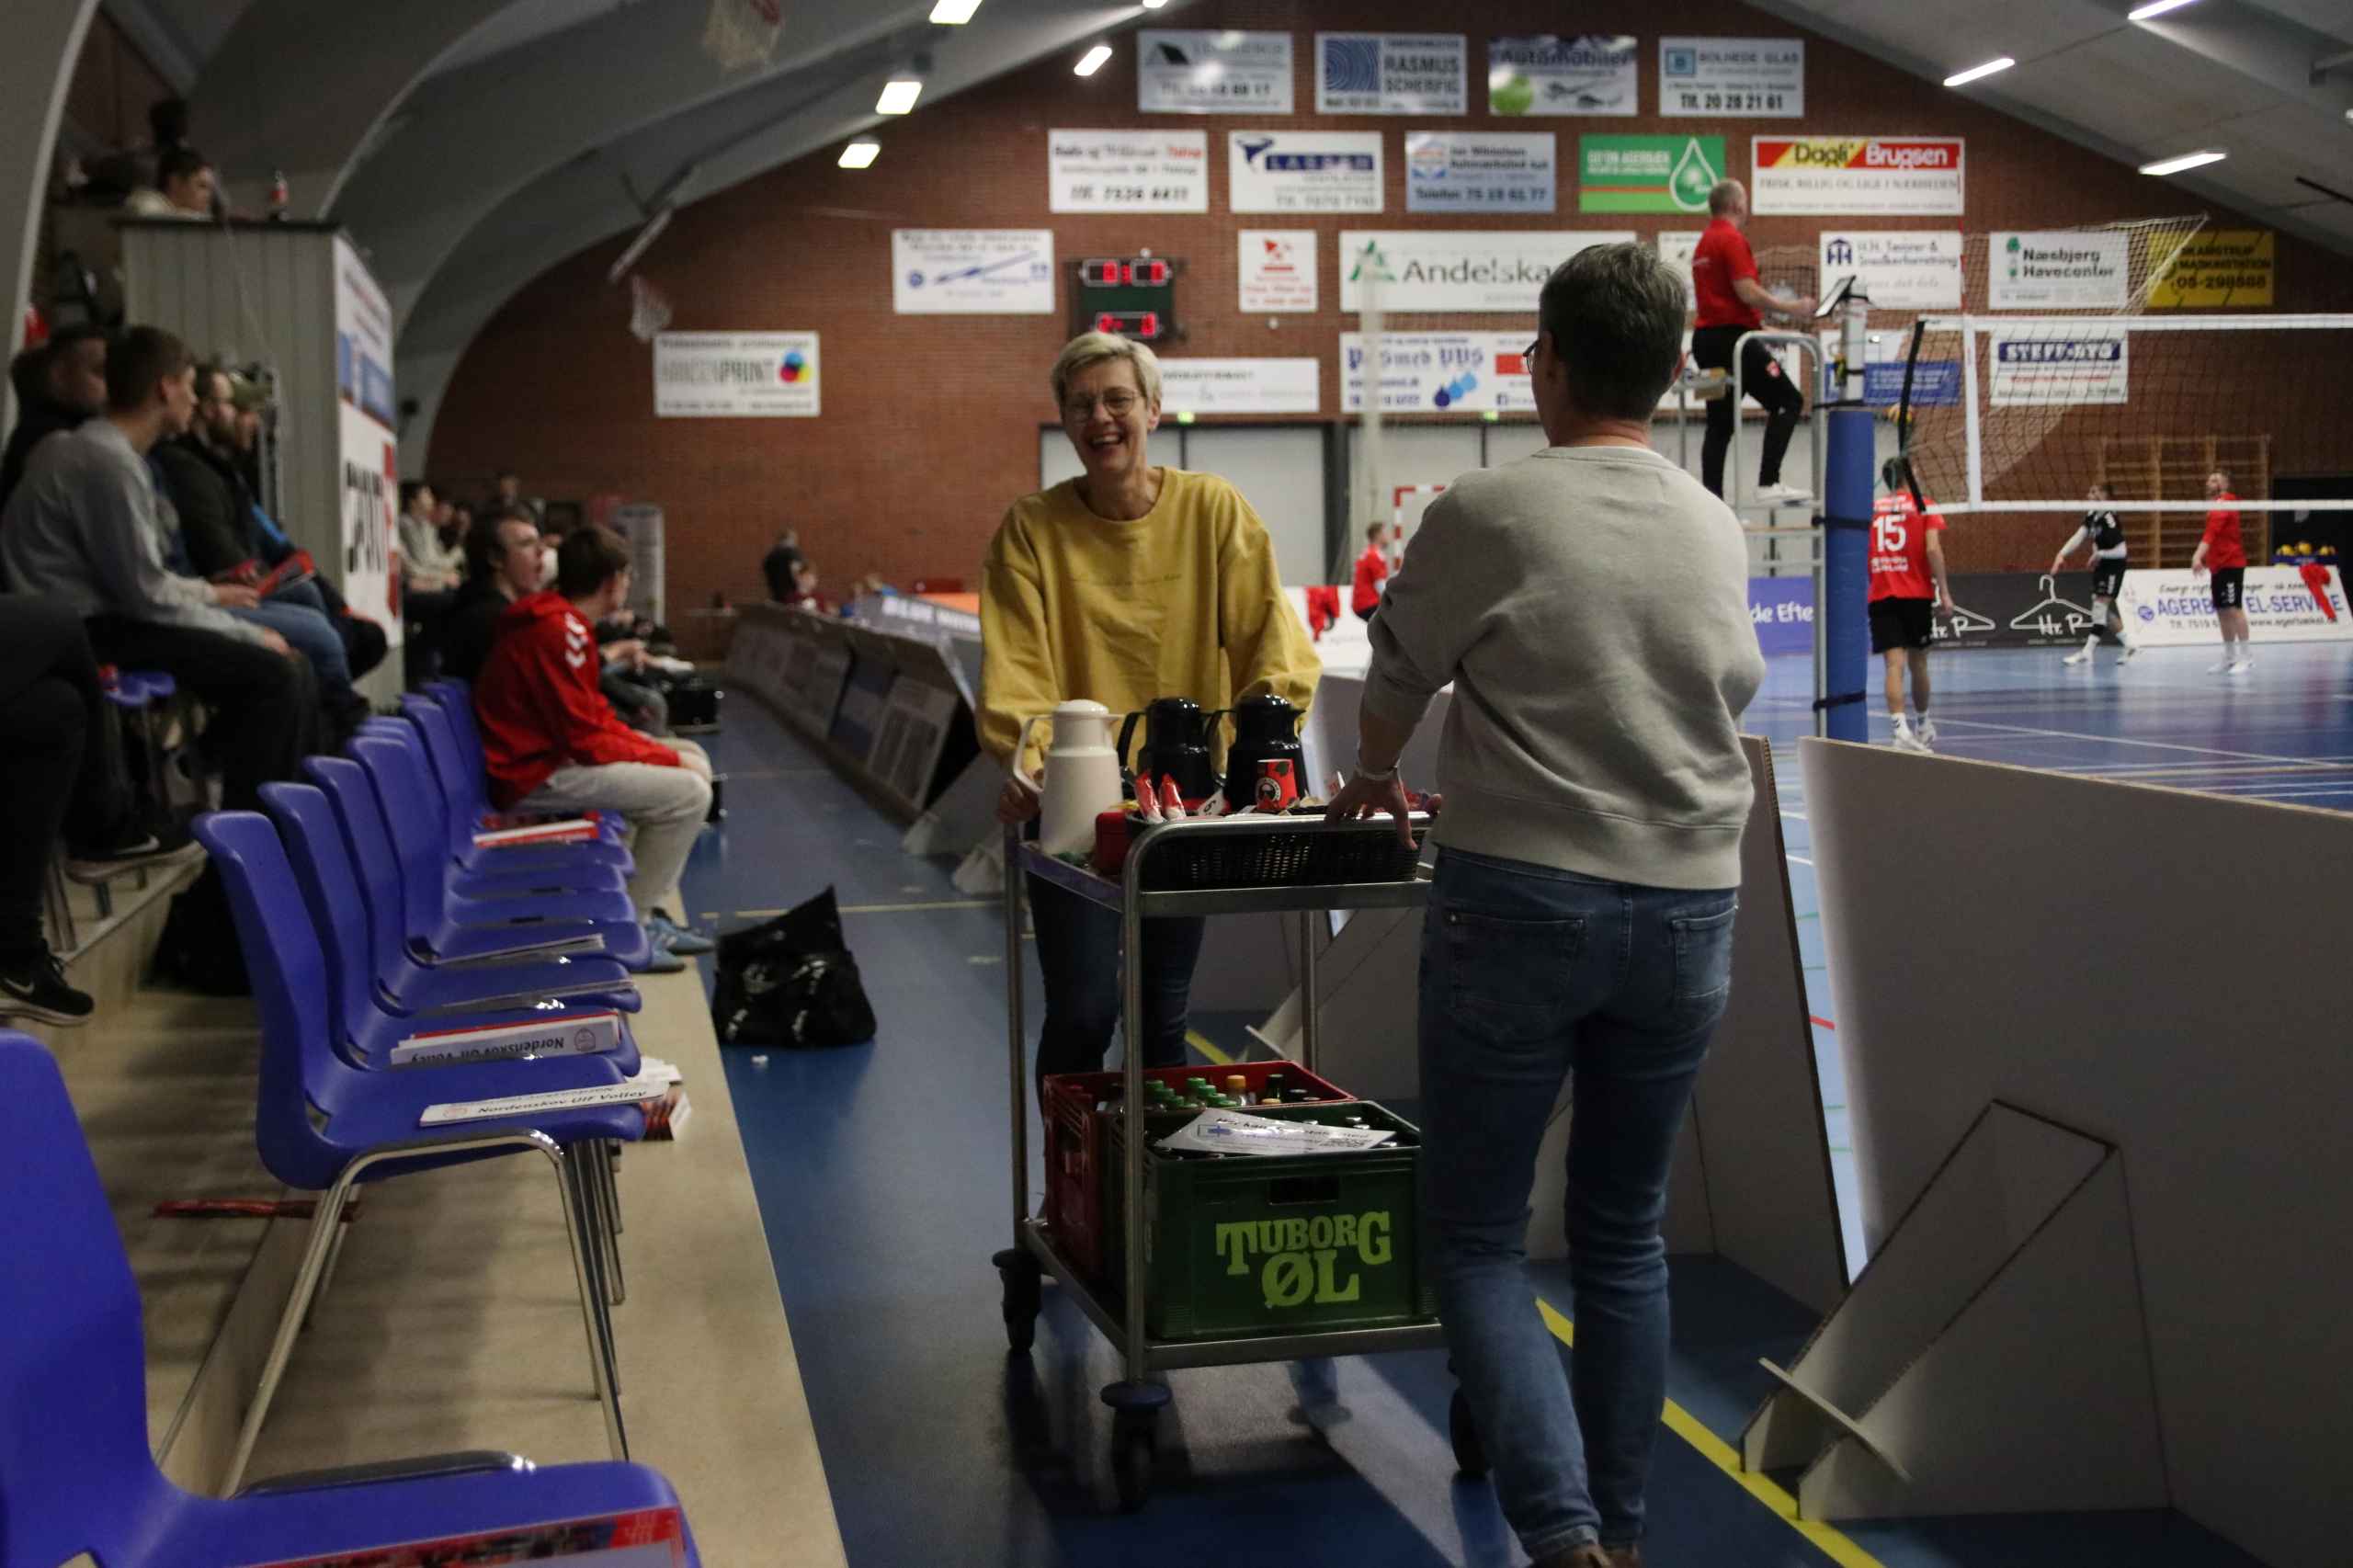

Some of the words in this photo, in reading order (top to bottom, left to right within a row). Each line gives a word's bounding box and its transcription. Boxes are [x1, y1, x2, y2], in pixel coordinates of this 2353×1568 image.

[1383, 55, 1460, 73] RASMUS
[1865, 142, 1948, 170] Brugsen
[1872, 514, 1907, 552] 15
[477, 1097, 567, 1115] Nordenskov
[1215, 1210, 1392, 1276] TUBORG
[1261, 1249, 1360, 1308] ØL
